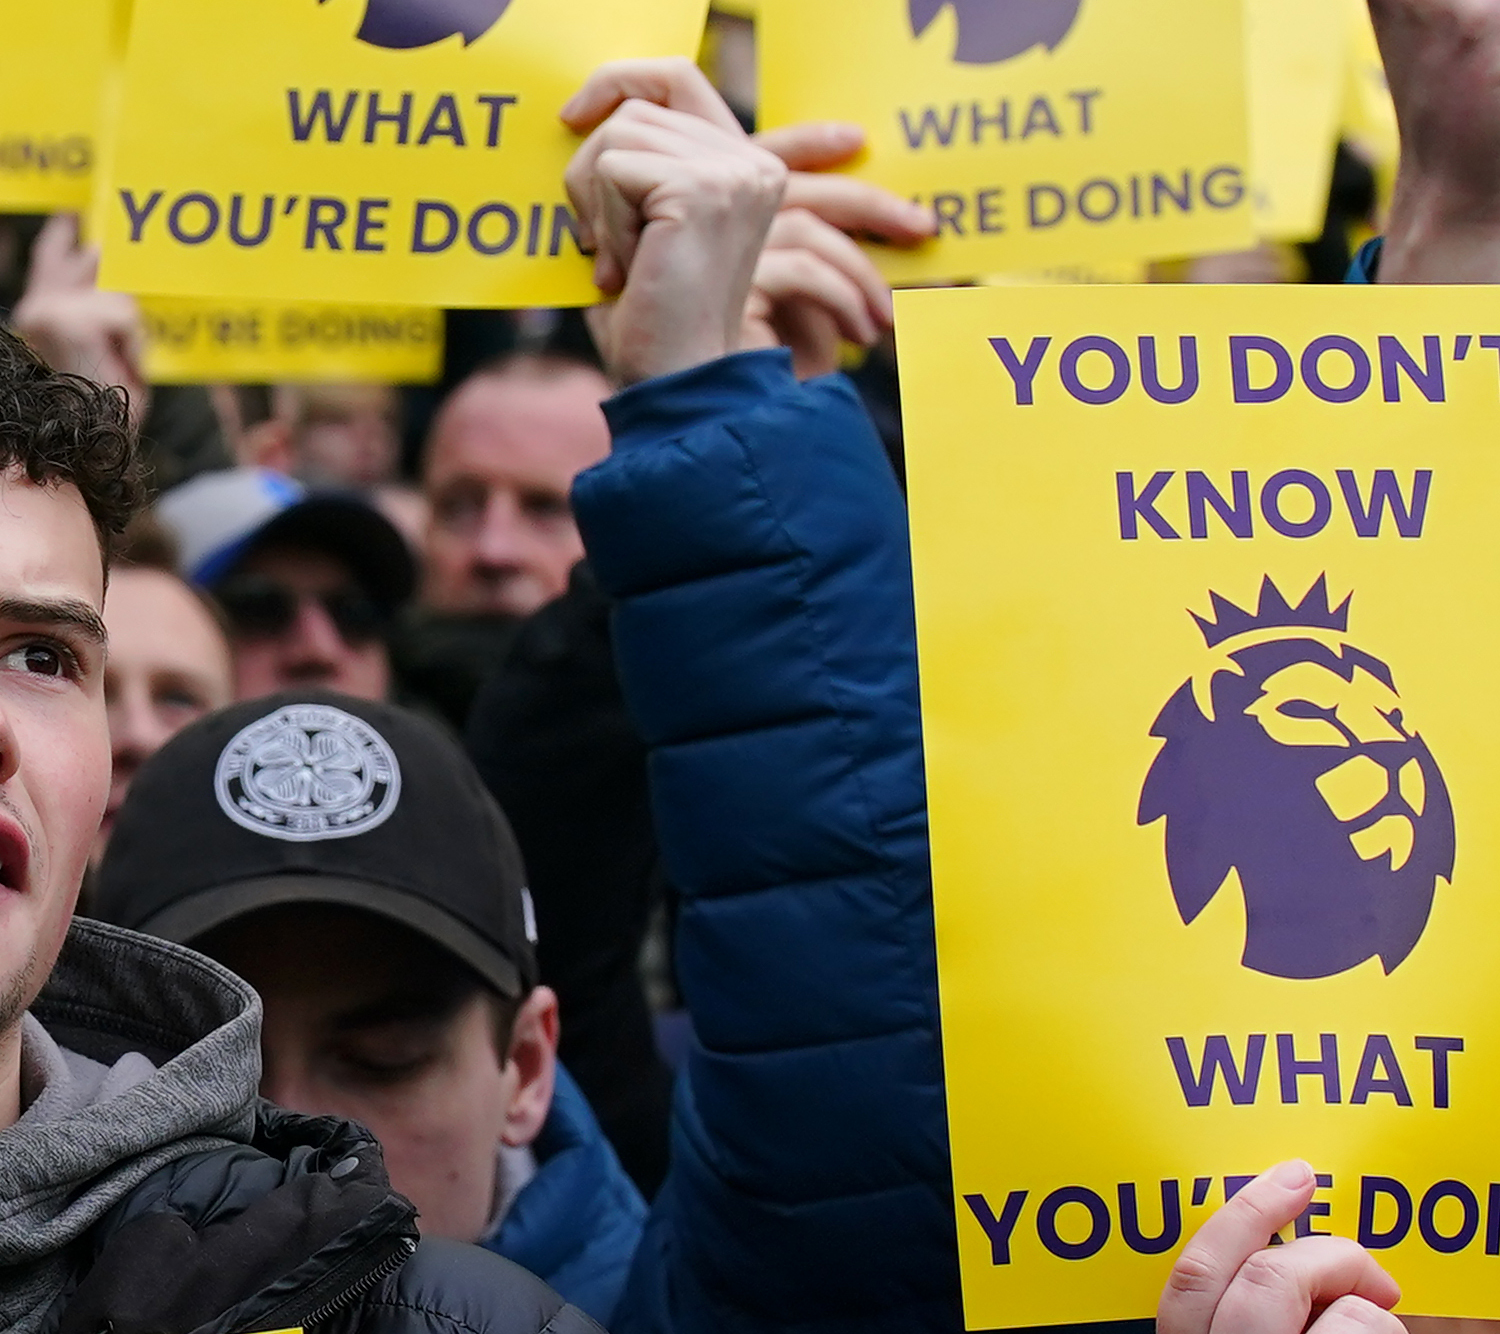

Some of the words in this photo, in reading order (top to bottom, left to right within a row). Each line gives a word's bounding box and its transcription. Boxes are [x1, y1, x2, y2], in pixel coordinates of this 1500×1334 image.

[288, 90, 516, 147] WHAT
[900, 90, 1100, 149] WHAT
[121, 191, 389, 251] YOU'RE
[411, 201, 594, 256] DOIN
[1027, 166, 1245, 229] DOING
[988, 336, 1199, 405] YOU
[1116, 469, 1432, 540] KNOW
[1166, 1034, 1464, 1108] WHAT
